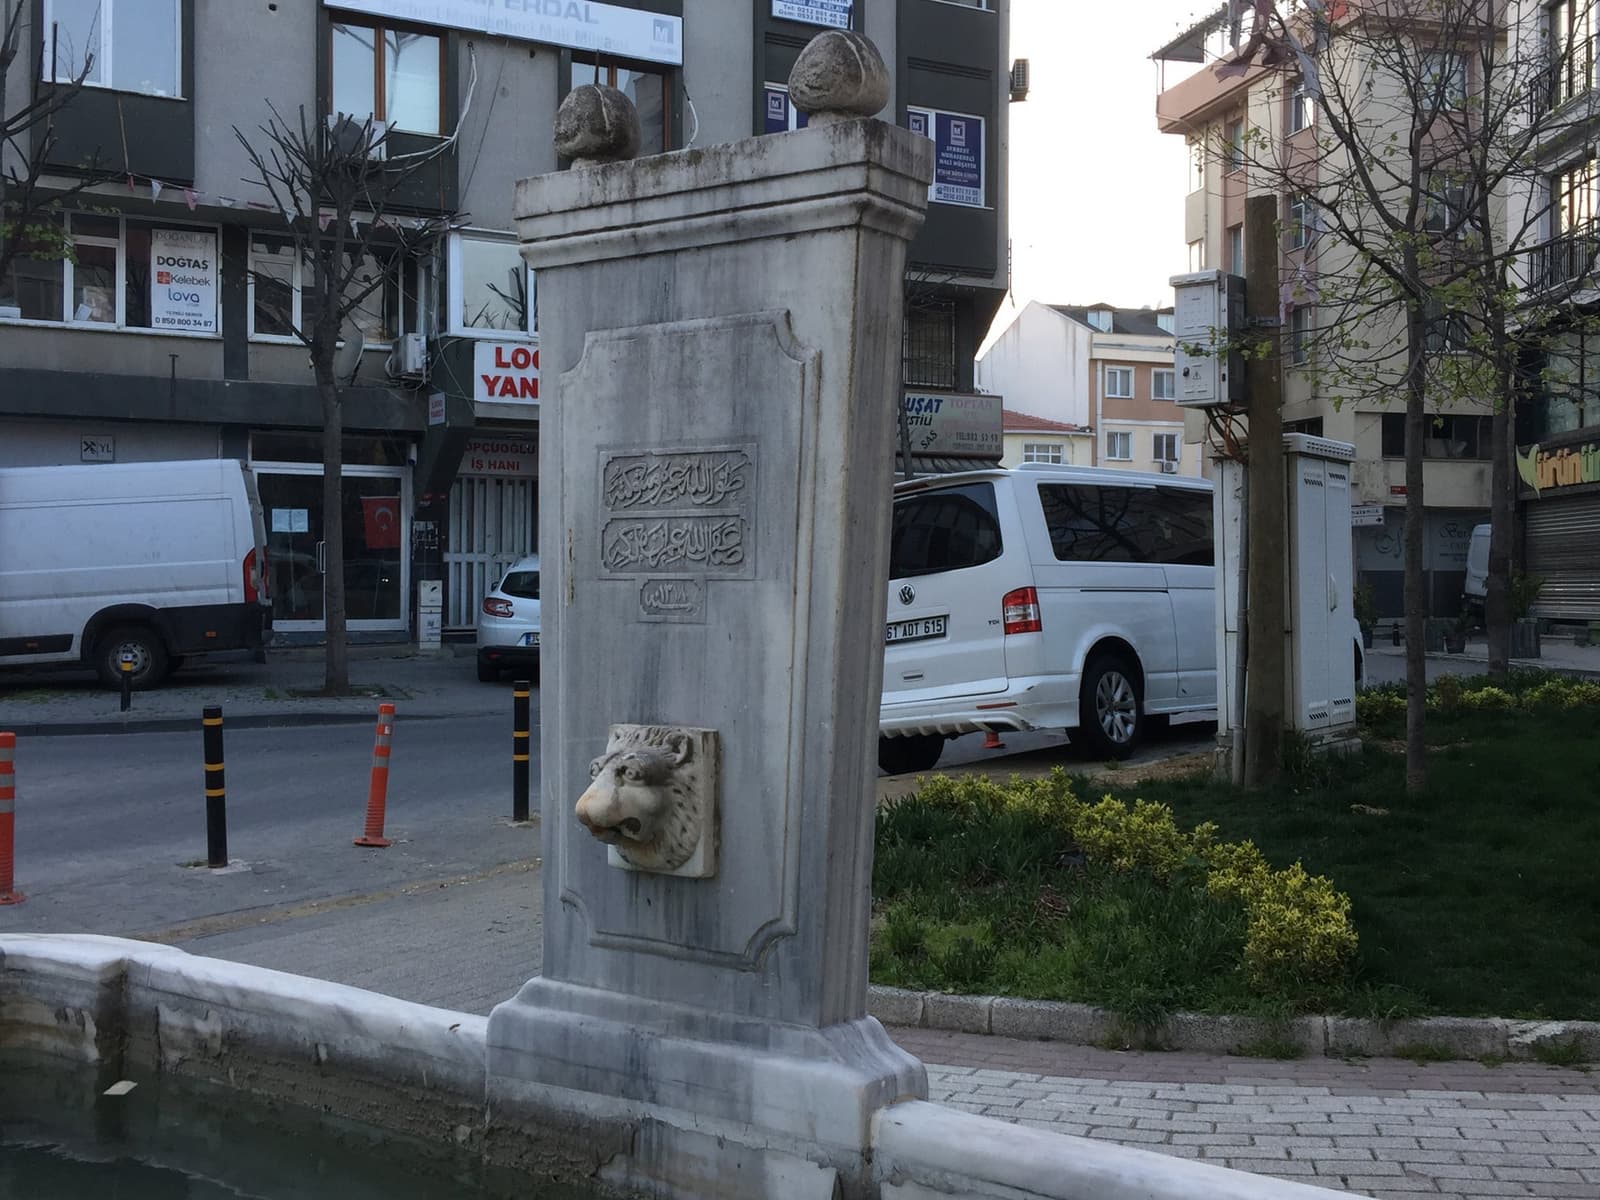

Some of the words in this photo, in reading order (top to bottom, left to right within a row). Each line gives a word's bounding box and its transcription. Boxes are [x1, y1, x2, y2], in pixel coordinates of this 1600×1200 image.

[171, 274, 211, 287] Kelebek
[481, 375, 539, 399] YAN
[488, 459, 520, 471] HANI
[886, 626, 898, 640] 61
[902, 622, 920, 637] ADT
[924, 619, 942, 634] 615
